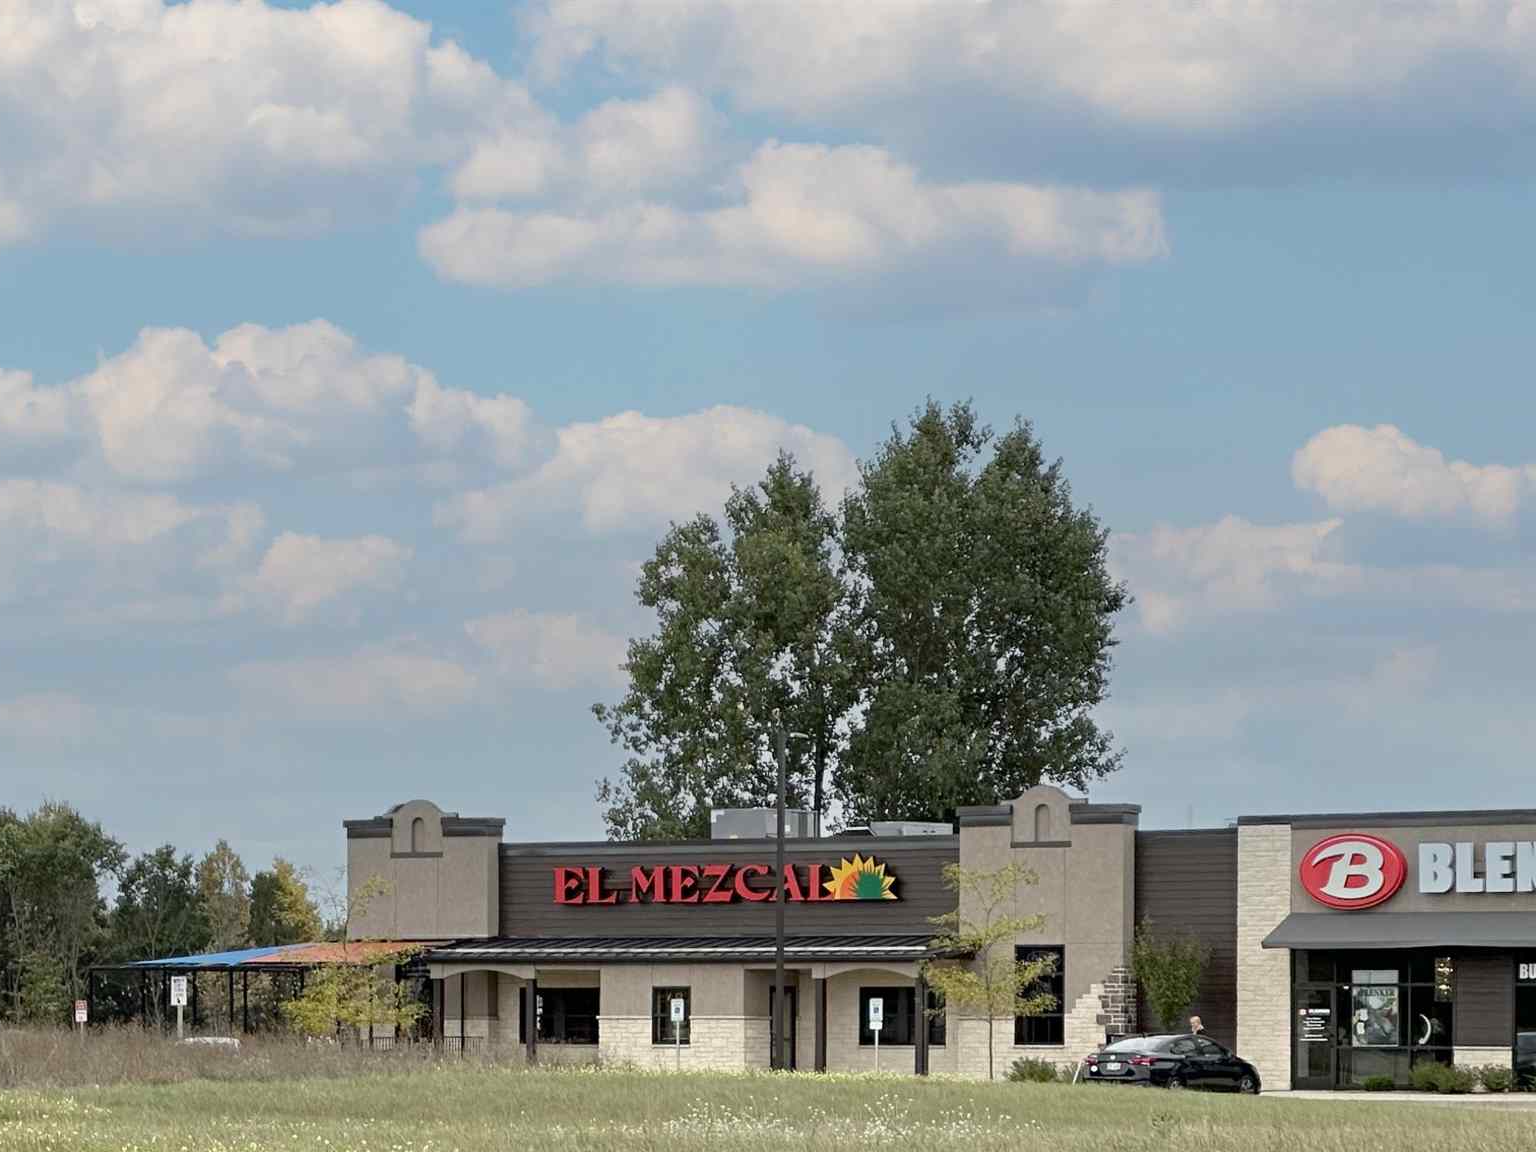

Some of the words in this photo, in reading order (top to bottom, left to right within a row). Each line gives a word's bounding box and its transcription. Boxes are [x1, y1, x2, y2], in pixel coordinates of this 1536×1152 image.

[553, 867, 617, 904] EL
[631, 864, 834, 904] MEZCAL
[1312, 841, 1385, 899] B
